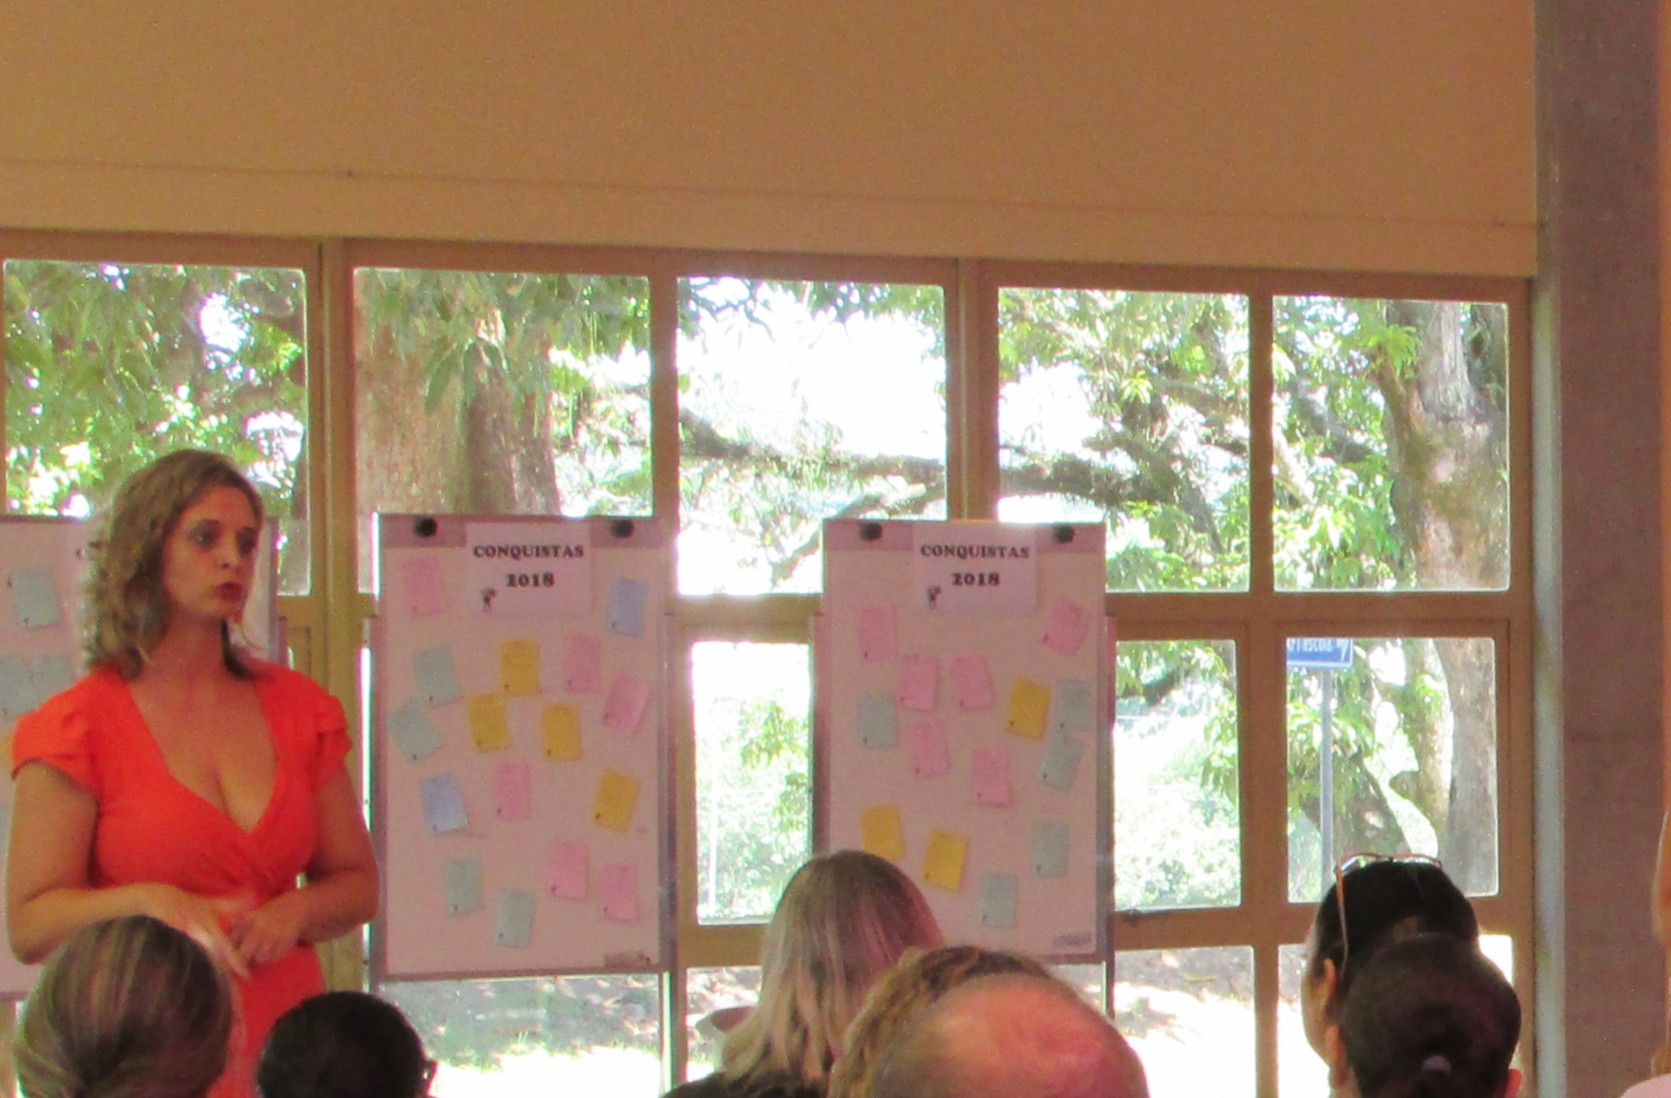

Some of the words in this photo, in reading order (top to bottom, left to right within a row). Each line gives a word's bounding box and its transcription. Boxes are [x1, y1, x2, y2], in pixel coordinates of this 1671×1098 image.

[473, 545, 584, 560] CONQUISTAS
[921, 545, 1029, 560] CONQUISTAS
[506, 573, 554, 587] 2018
[952, 572, 1000, 586] 2018
